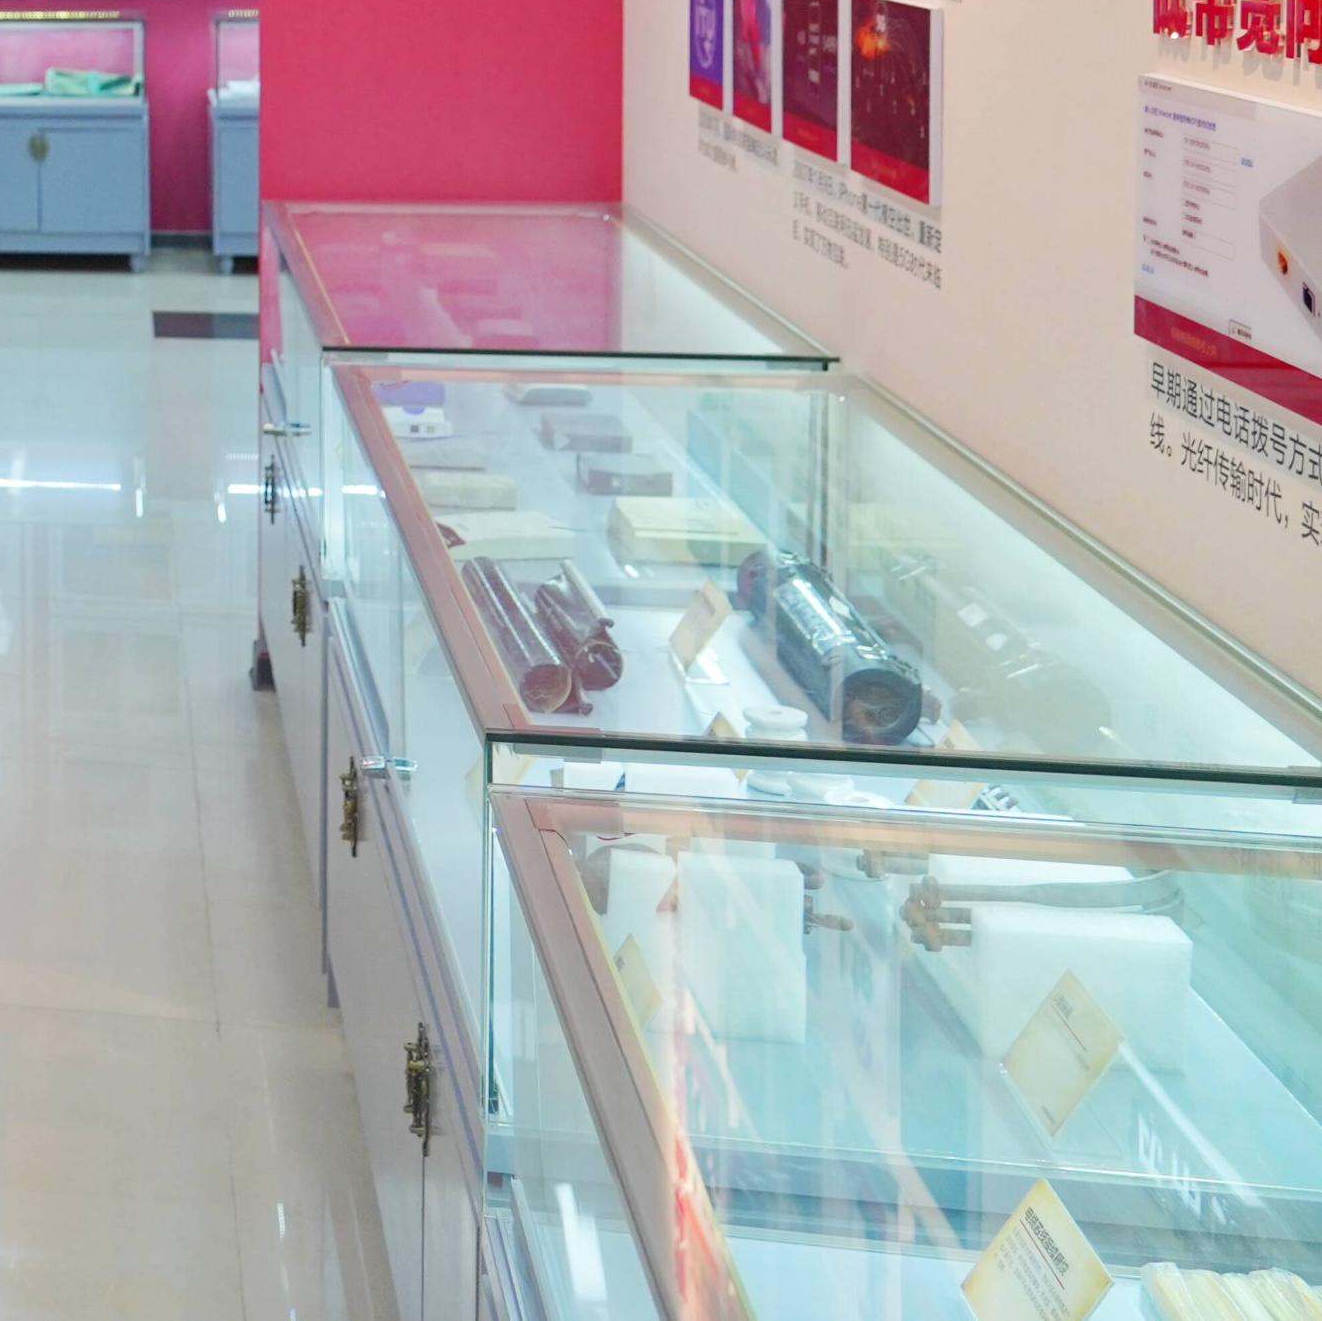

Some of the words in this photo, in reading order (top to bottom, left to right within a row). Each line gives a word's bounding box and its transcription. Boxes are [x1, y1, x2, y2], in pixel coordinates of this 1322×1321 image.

[1150, 412, 1322, 546] 线。光纤传输时代，实
